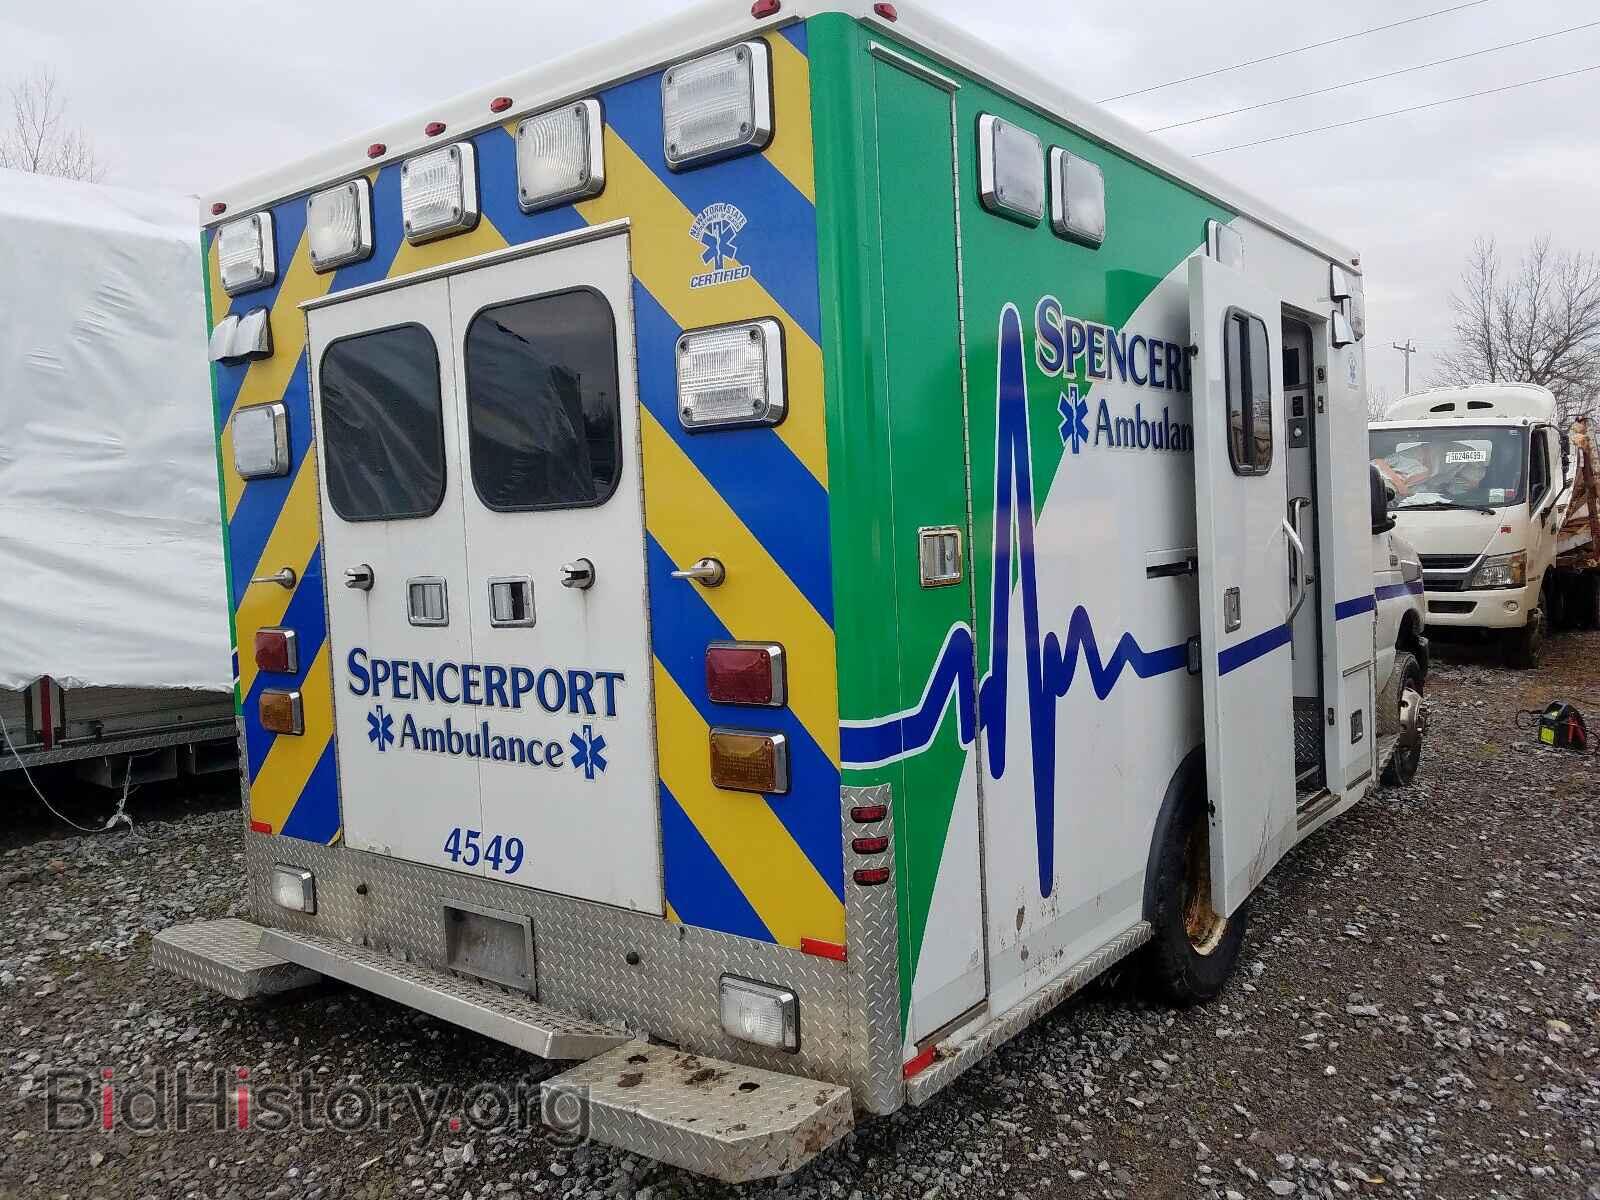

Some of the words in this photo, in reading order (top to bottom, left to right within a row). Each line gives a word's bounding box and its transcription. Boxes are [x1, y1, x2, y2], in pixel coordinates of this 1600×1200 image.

[689, 214, 704, 236] NEW
[704, 204, 724, 217] YORK
[725, 204, 746, 226] STATE
[690, 266, 750, 288] CERTIFIED
[347, 647, 625, 717] SPENCERPORT
[399, 713, 564, 768] Ambulance
[444, 827, 524, 874] 4549
